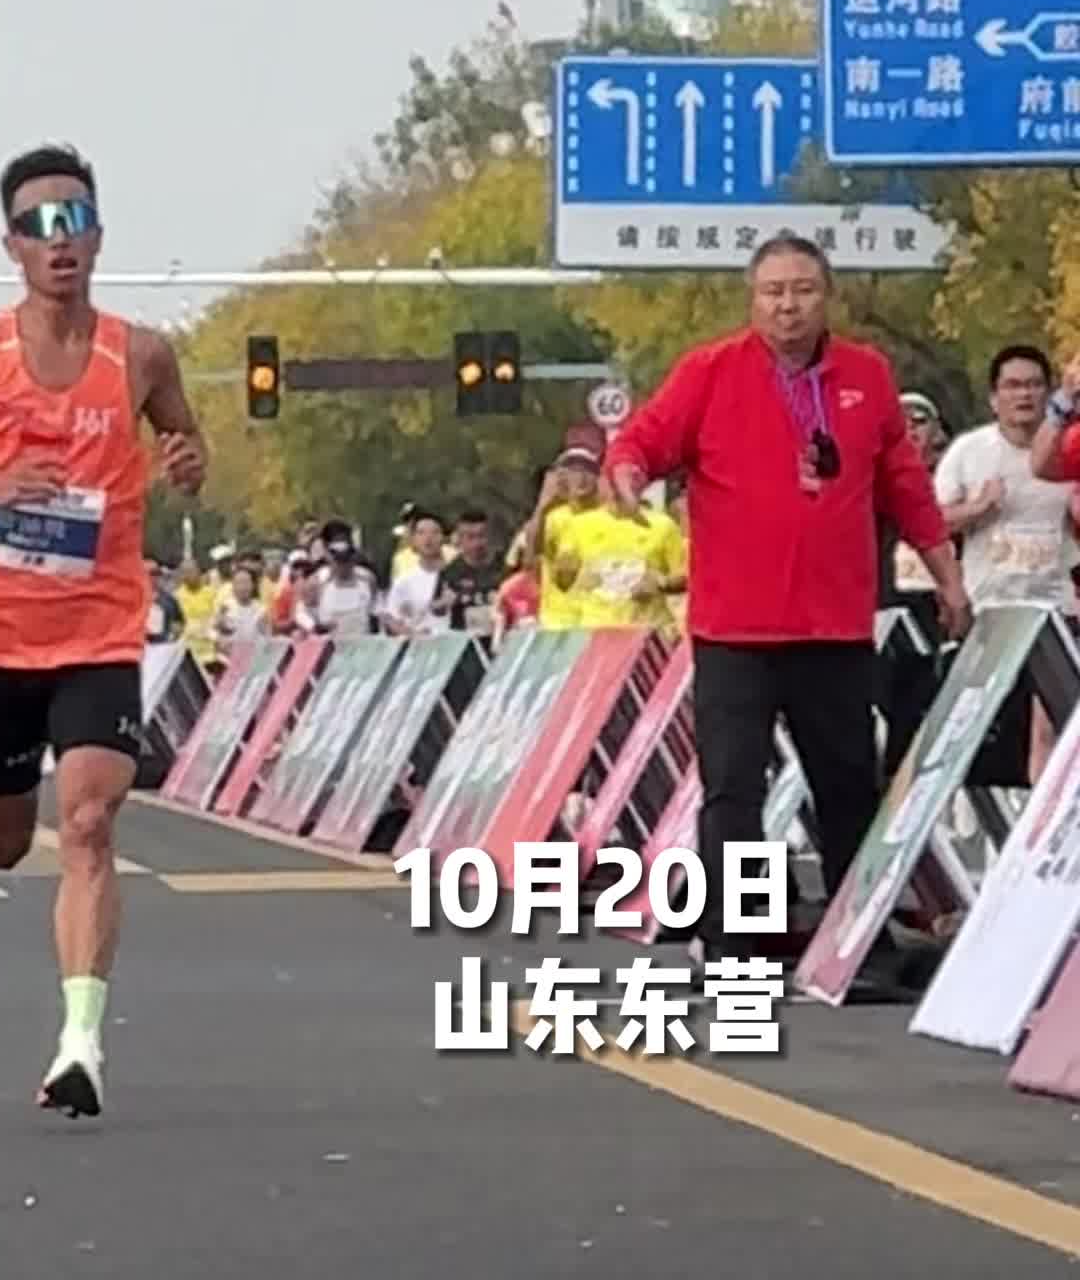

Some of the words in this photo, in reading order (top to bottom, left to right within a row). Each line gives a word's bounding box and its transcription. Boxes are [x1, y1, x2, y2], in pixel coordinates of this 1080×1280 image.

[843, 19, 910, 39] Yunhe
[914, 18, 965, 39] Road
[843, 55, 964, 94] 南一路
[843, 99, 907, 123] Nanyi
[913, 97, 965, 119] Road
[597, 393, 625, 417] 60
